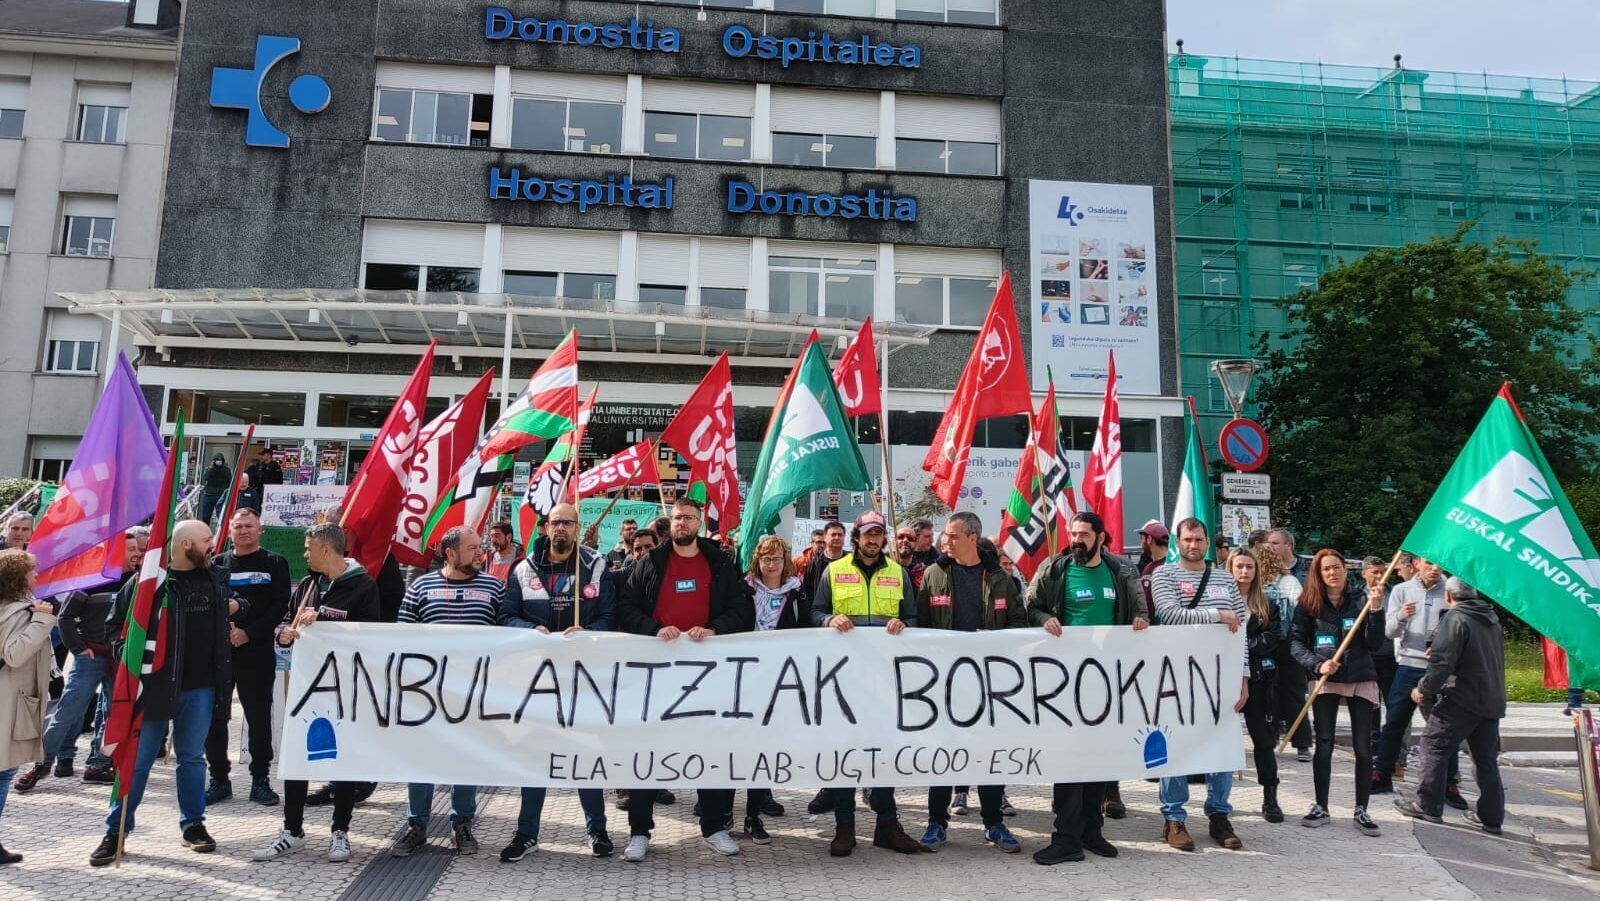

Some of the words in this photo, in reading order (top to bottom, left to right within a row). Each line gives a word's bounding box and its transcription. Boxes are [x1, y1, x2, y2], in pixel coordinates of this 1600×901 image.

[485, 7, 681, 53] Donostia
[723, 25, 921, 68] Ospitalea
[489, 167, 674, 213] Hospital
[727, 180, 918, 222] Donostia
[1087, 206, 1128, 215] Osakidetza
[605, 406, 673, 416] UNIBERTSITATE
[1445, 507, 1516, 552] EUSKAL
[677, 581, 694, 589] ELA
[1076, 590, 1092, 598] ELA
[290, 651, 857, 728] ANBULANTZIAK
[893, 653, 1221, 732] BORROKAN
